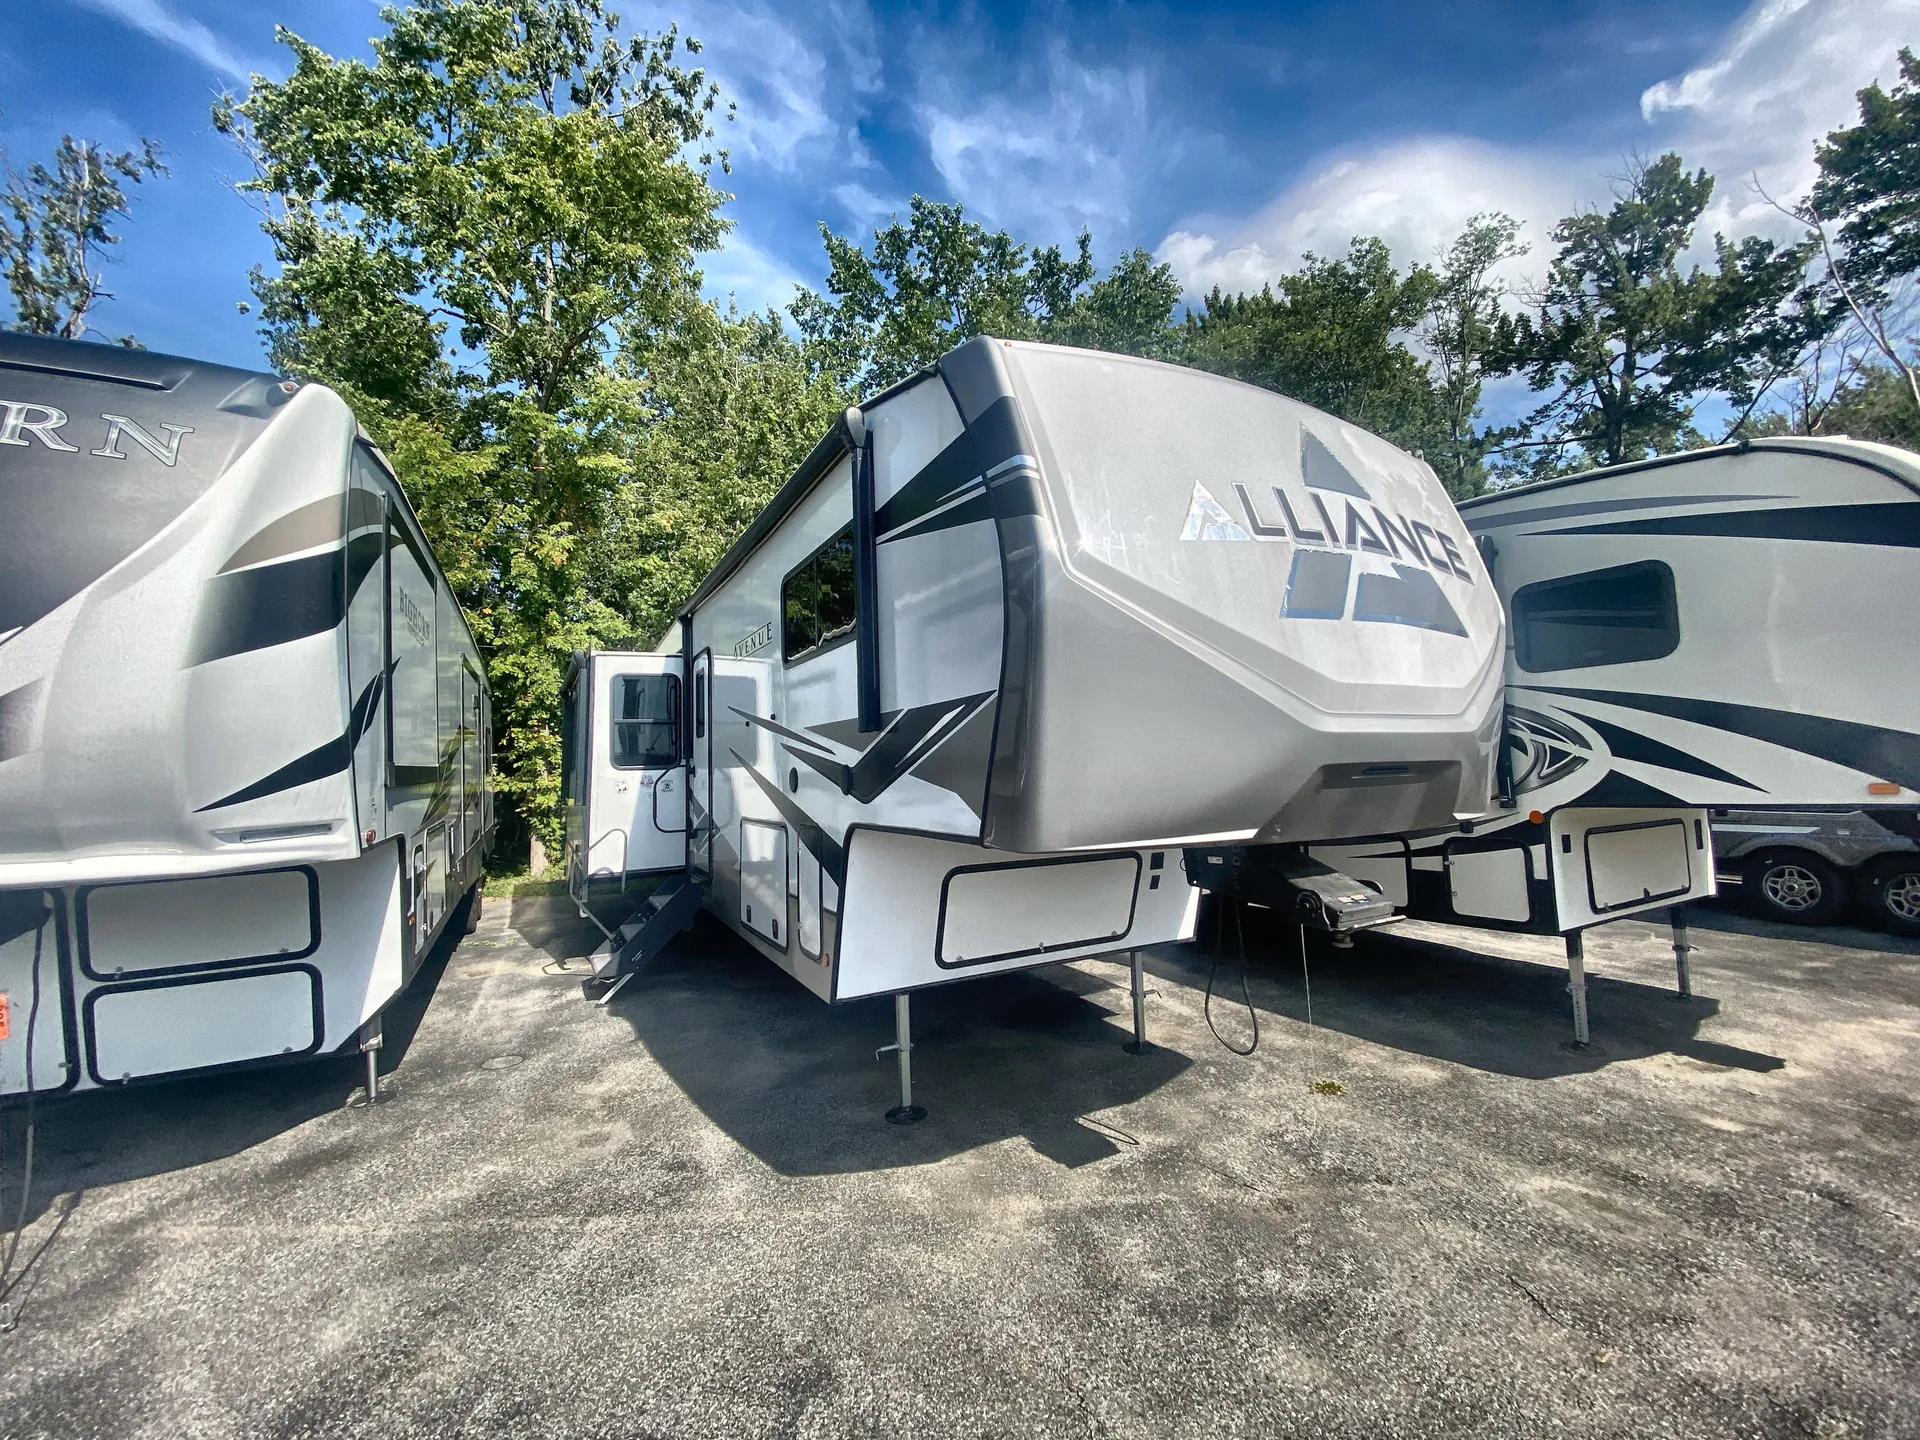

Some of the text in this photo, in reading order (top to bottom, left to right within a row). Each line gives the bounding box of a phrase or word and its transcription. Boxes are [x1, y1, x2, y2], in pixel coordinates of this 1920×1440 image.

[1180, 479, 1476, 586] ALLIANCE
[399, 586, 431, 642] BIGHORN
[732, 621, 772, 659] AVENUE
